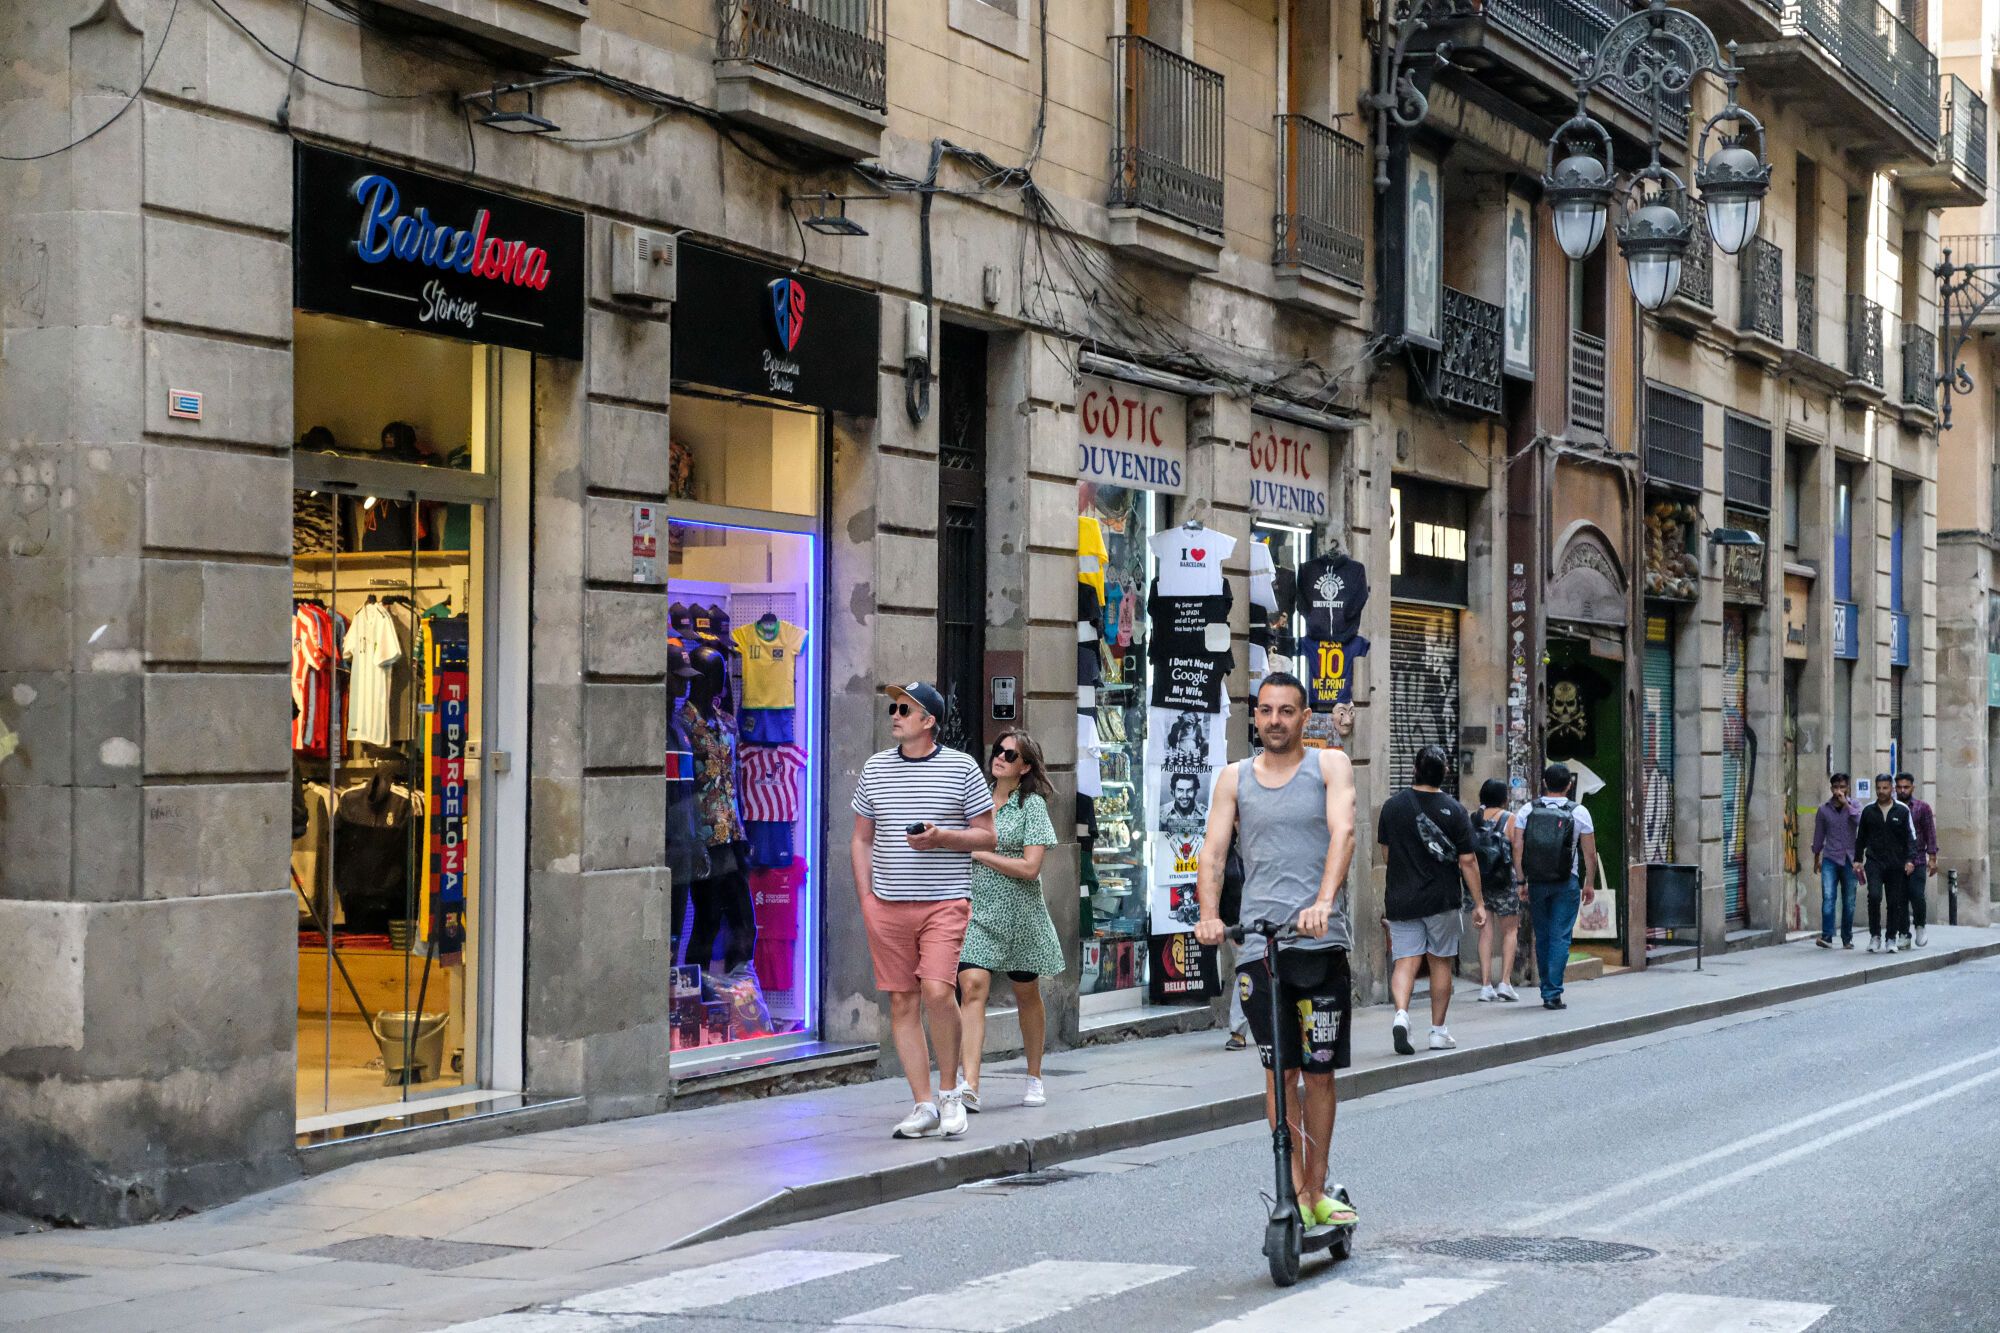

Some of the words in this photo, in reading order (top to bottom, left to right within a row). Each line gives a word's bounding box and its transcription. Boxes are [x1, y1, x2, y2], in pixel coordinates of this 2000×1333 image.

[349, 175, 550, 290] Barcelona
[418, 279, 478, 329] Stories
[762, 349, 800, 376] Barcelona
[769, 370, 794, 393] Stories
[1082, 386, 1163, 447] GÒTIC
[1181, 548, 1187, 560] I
[1173, 657, 1193, 667] Don't
[1194, 659, 1214, 670] Need
[1318, 648, 1345, 679] 10
[1171, 667, 1208, 686] Google
[1313, 679, 1324, 690] WE
[1326, 679, 1346, 690] PRINT
[448, 684, 460, 716] FC
[1172, 685, 1184, 696] My
[1185, 686, 1203, 697] Wife
[1319, 689, 1339, 700] NAME
[1182, 697, 1209, 708] Everything
[1160, 763, 1182, 773] PABLO
[1183, 764, 1213, 774] ESCOBAR
[445, 723, 460, 890] BARCELONA
[1164, 981, 1186, 993] BELLA
[1186, 980, 1204, 991] CIAO
